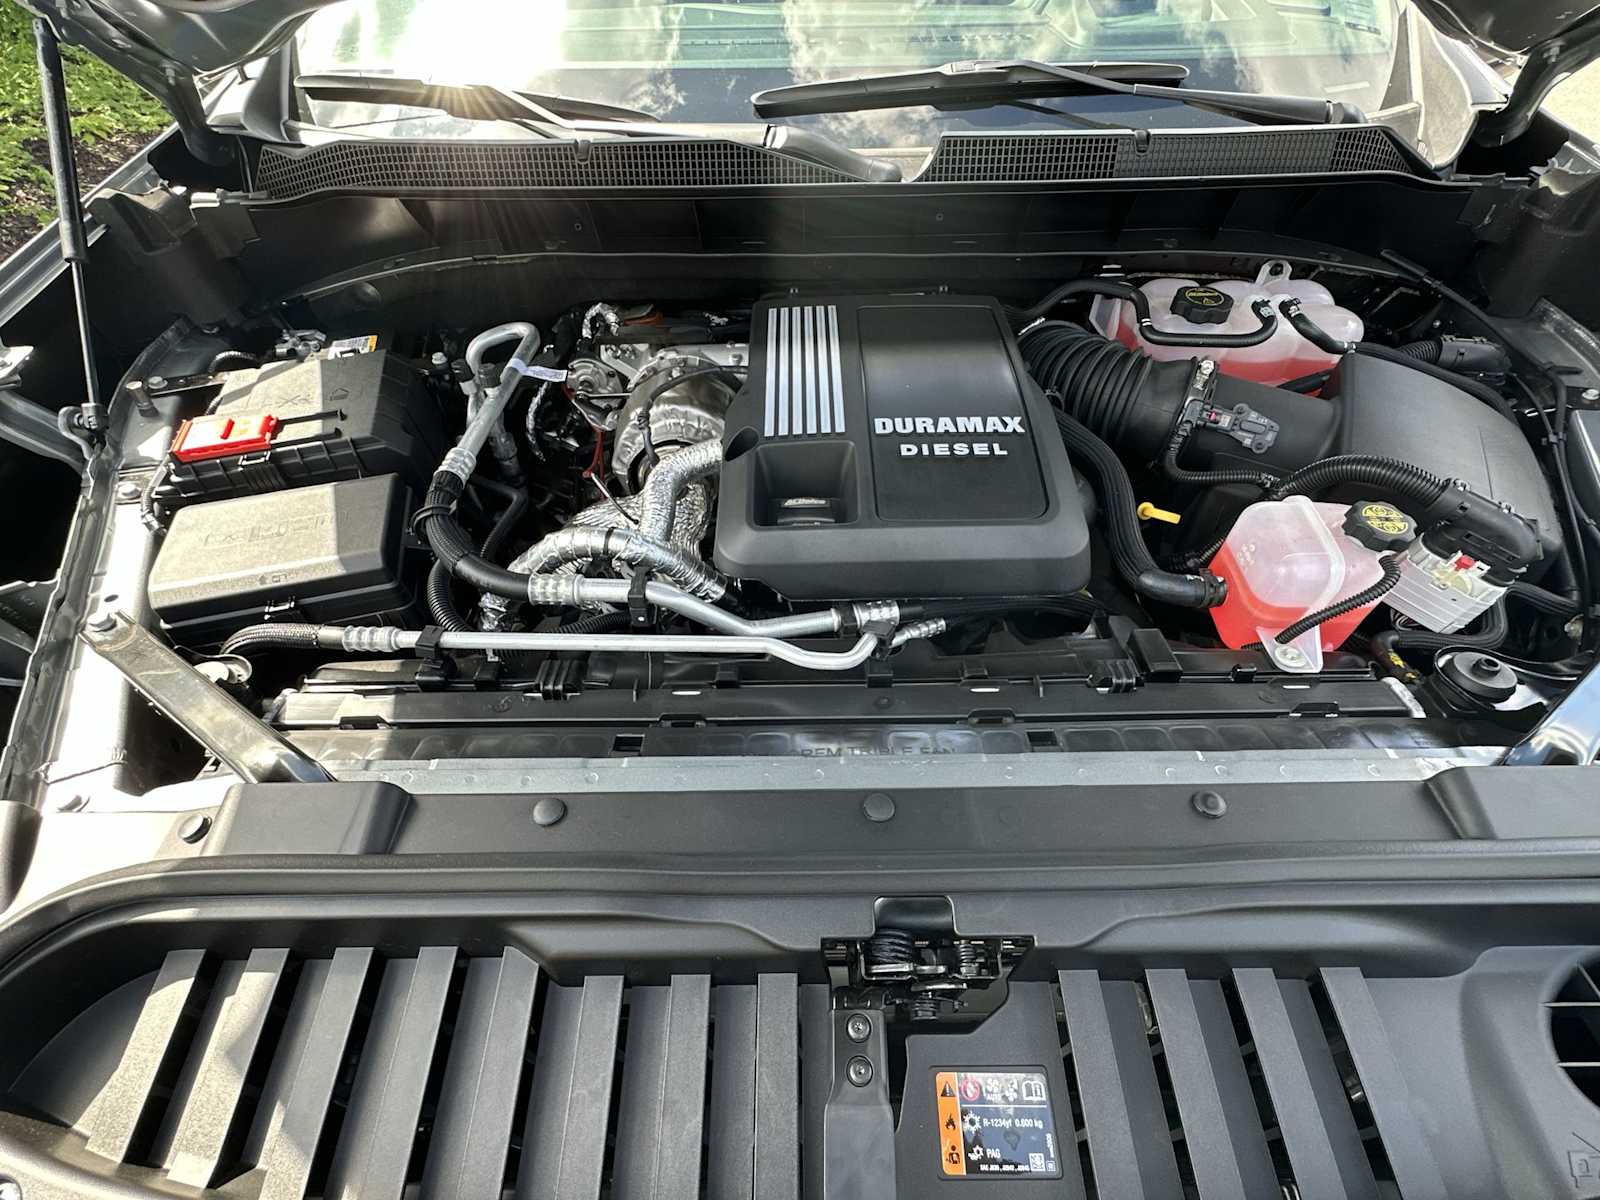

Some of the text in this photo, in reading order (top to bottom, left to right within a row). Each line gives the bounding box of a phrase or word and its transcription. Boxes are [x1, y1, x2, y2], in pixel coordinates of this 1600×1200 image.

[874, 416, 1025, 434] DURAMAX
[900, 443, 1008, 456] DIESEL
[983, 1119, 1012, 1129] R-1234yf
[986, 1148, 1001, 1158] PAG
